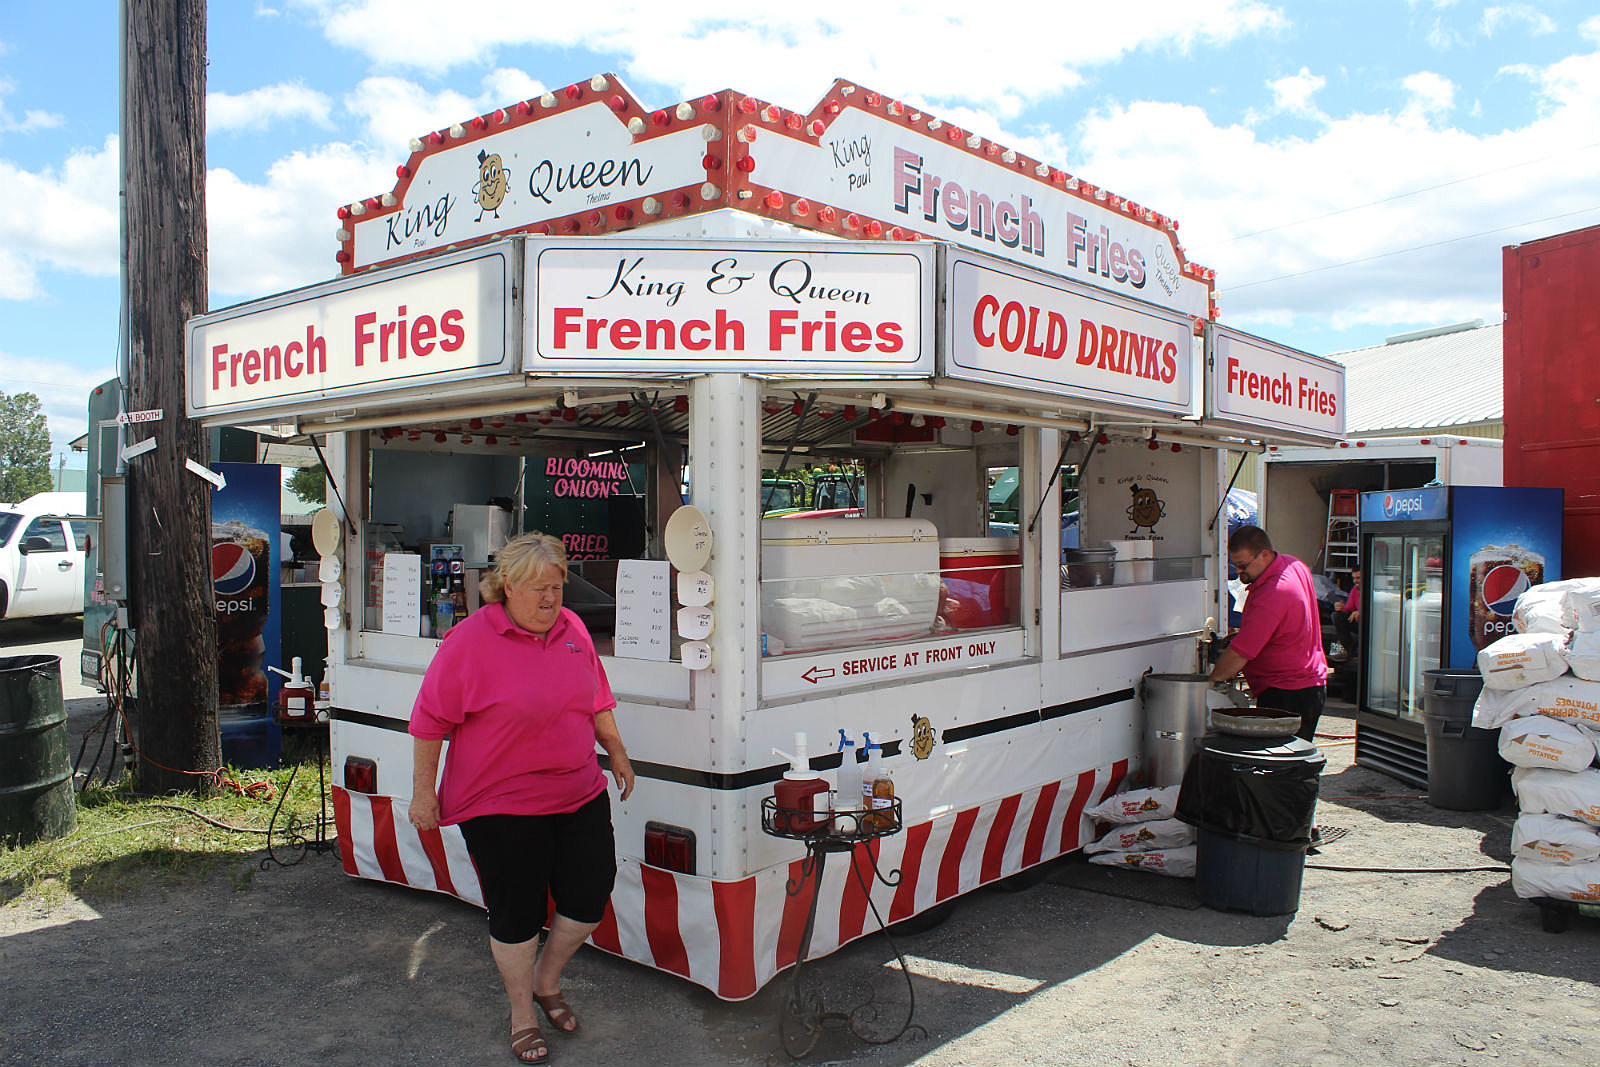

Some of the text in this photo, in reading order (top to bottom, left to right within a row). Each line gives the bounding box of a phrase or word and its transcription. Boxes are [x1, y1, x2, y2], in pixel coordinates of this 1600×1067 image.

[830, 133, 871, 168] King
[848, 169, 871, 192] Paul
[386, 157, 654, 251] King Queen
[894, 146, 1146, 290] French Fries
[586, 257, 871, 306] King & Queen
[553, 306, 904, 354] French Fries
[973, 294, 1178, 384] COLD DRINKS
[212, 304, 465, 390] French Fries
[1227, 357, 1337, 417] French Fries
[135, 411, 160, 422] BOOTH
[545, 457, 629, 480] BLOOMING
[554, 478, 620, 499] ONIONS
[1395, 494, 1423, 515] pepsi
[562, 533, 609, 553] FRIED
[215, 597, 254, 615] epsi
[1484, 621, 1516, 636] pep
[842, 641, 996, 676] SERVICE AT FRONT ONLY
[1555, 697, 1598, 711] POTATOES
[1580, 711, 1600, 723] EF'S
